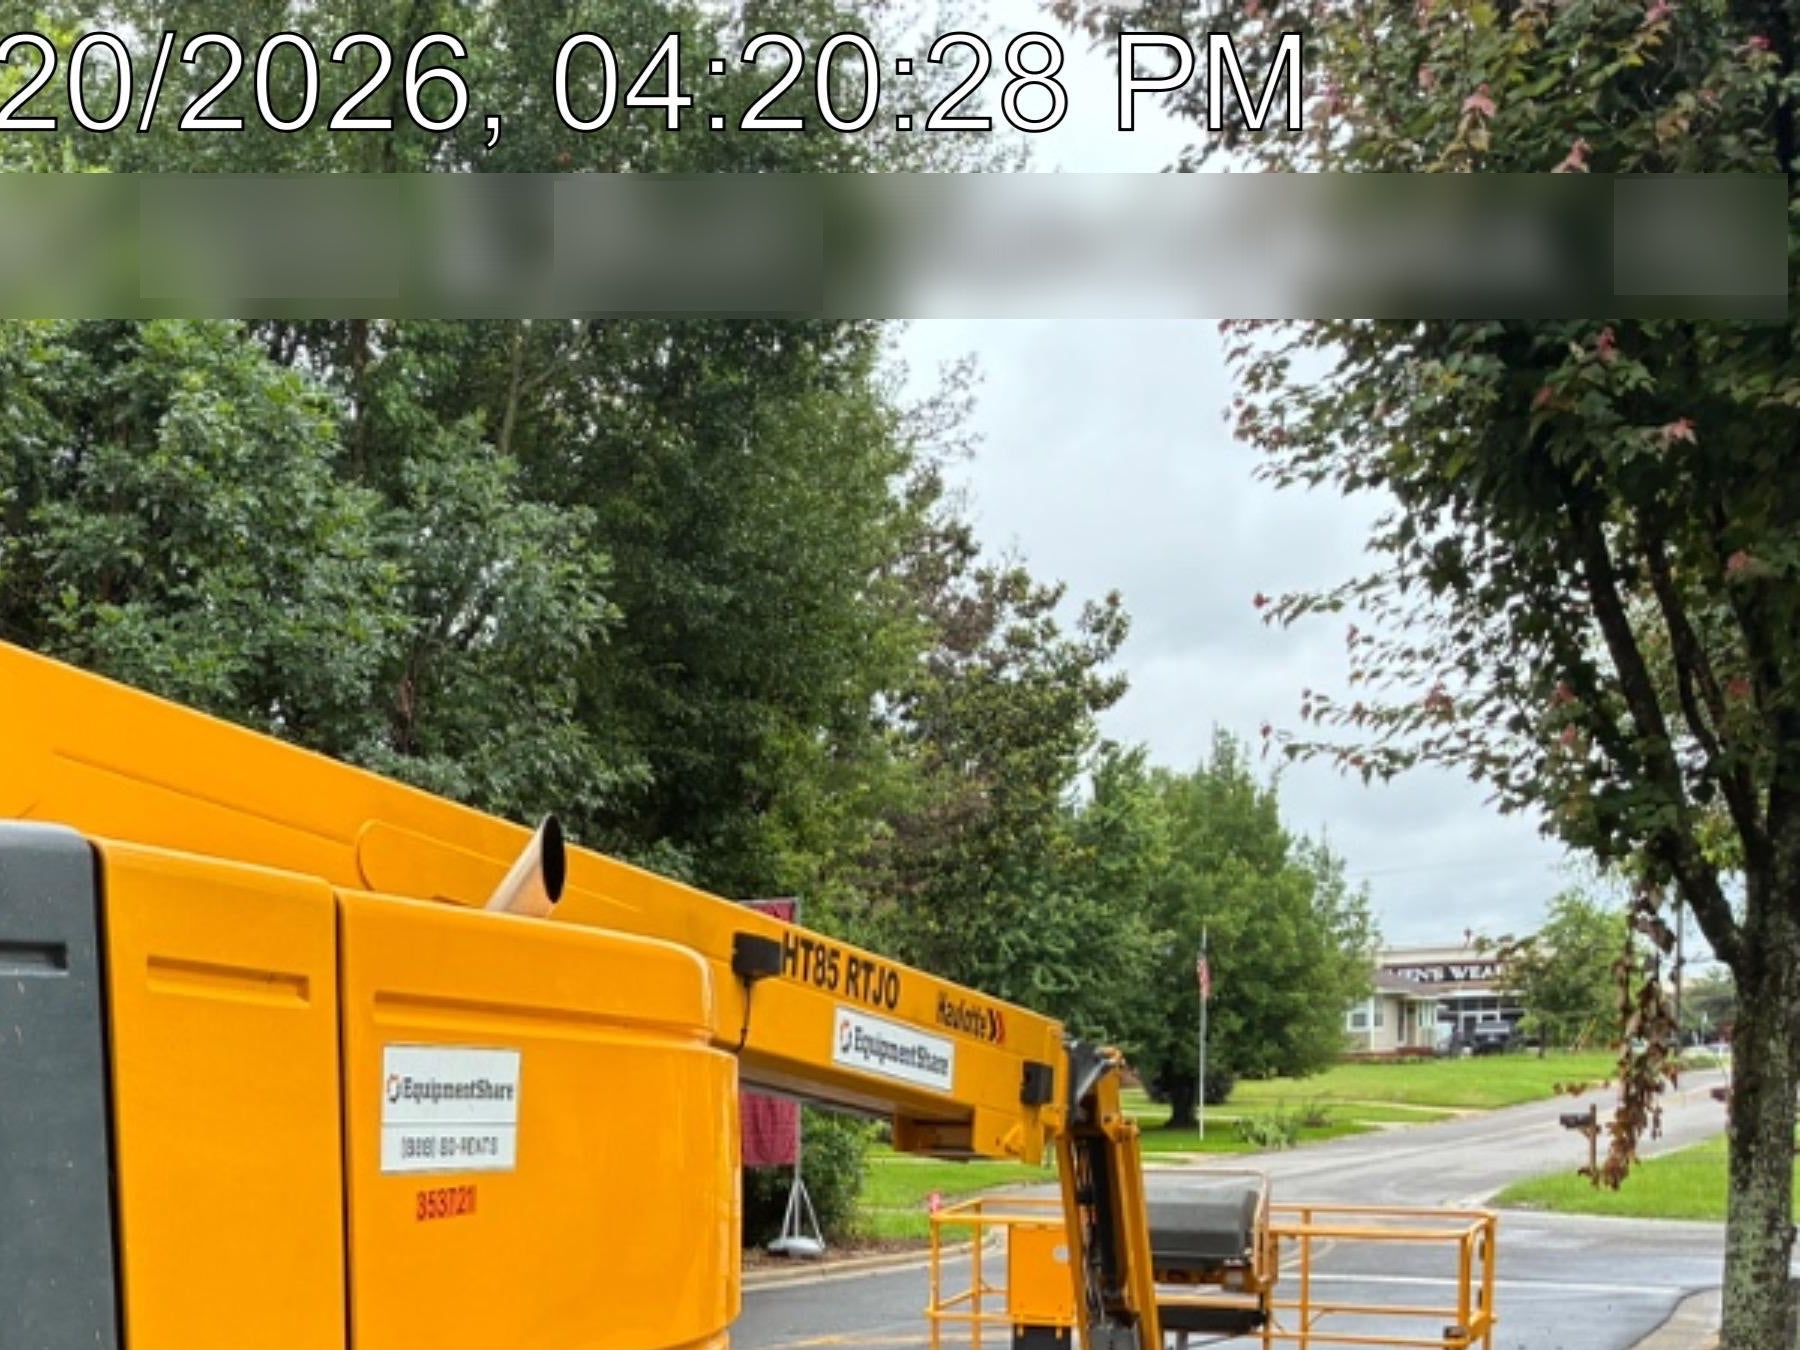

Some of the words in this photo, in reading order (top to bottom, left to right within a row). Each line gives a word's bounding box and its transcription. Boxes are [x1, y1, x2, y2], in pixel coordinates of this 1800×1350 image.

[782, 929, 840, 992] HT85
[937, 991, 988, 1041] Haulotte
[854, 1025, 949, 1076] EquipmentShare
[403, 1076, 515, 1104] EquipmentShare
